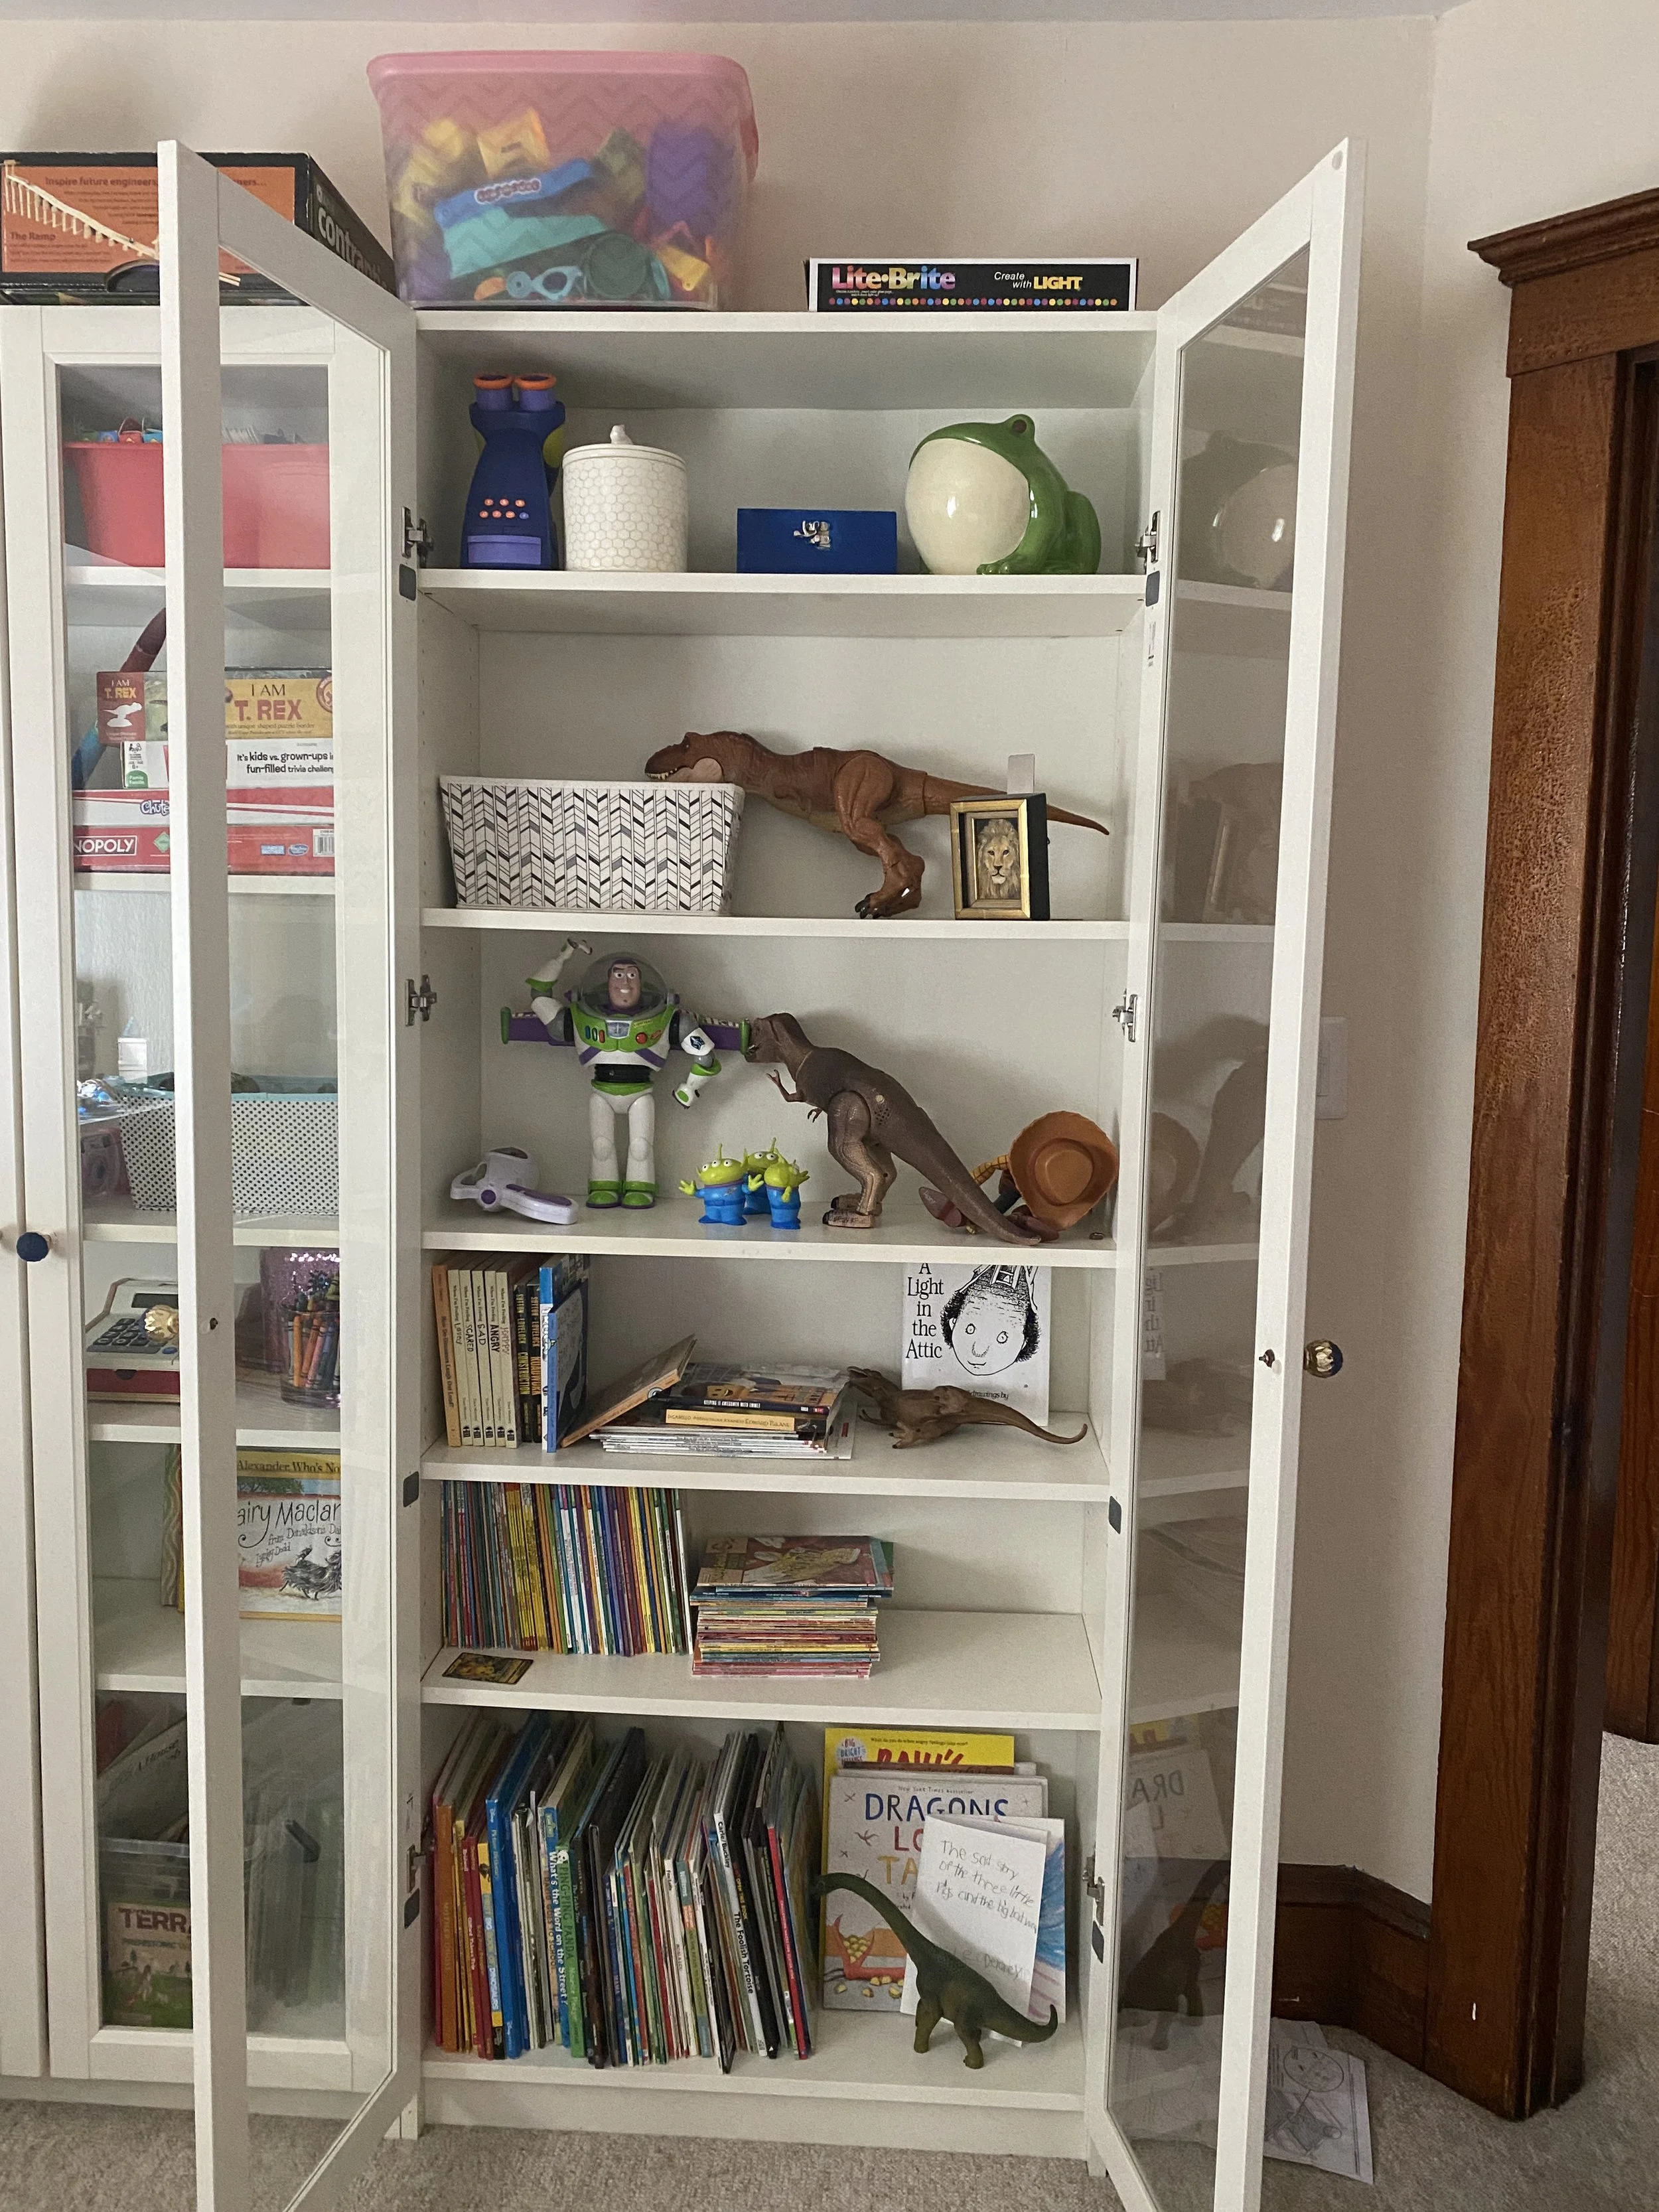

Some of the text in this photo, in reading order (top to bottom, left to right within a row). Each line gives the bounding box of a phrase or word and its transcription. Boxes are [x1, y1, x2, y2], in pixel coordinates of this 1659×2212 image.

[45, 177, 78, 186] Inspire
[80, 176, 108, 185] future
[29, 232, 56, 242] Ramp
[994, 271, 1025, 280] Create
[1033, 276, 1082, 290] LIGHT
[115, 687, 136, 698] REX
[252, 684, 285, 696] I AM
[234, 699, 303, 721] T. REX
[249, 751, 268, 761] kids
[281, 752, 328, 763] grown-ups
[246, 764, 286, 774] fun-filled
[918, 1262, 932, 1274] A
[907, 1277, 944, 1299] Light
[516, 1293, 524, 1313] SUTTON
[916, 1301, 932, 1317] in
[465, 1325, 474, 1352] SCARED
[477, 1323, 486, 1345] SAD
[490, 1324, 500, 1353] ANGRY
[517, 1318, 526, 1344] LOVELOCK
[532, 1321, 540, 1347] LOVELOCK
[912, 1319, 936, 1336] the
[500, 1327, 510, 1355] HAPPY
[906, 1339, 942, 1359] Attic
[518, 1352, 530, 1394] CONSTRUCTION
[1001, 1392, 1009, 1400] by
[293, 1461, 323, 1473] Who's
[326, 1463, 340, 1473] No
[275, 1500, 341, 1528] Maclar
[268, 1523, 326, 1546] from Donaldson's
[275, 1542, 291, 1555] Dodd
[840, 1747, 861, 1757] BRIGHT
[844, 1738, 855, 1748] BIG
[865, 1793, 1009, 1822] DRAGONS
[549, 1851, 559, 1885] What's
[940, 1840, 966, 1860] The
[997, 1861, 1019, 1881] story
[560, 1867, 573, 1920] PING-PING
[680, 1871, 688, 1897] Willems
[973, 1872, 1009, 1894] three
[1009, 1885, 1034, 1907] little
[551, 1889, 560, 1905] the
[718, 1821, 754, 1994] Carle/Buckley The Foolish Tortoise
[958, 1891, 977, 1904] and
[979, 1895, 994, 1909] the
[118, 1906, 190, 1934] TERR
[553, 1907, 563, 1932] Word
[556, 1935, 563, 1945] on
[563, 1925, 575, 1959] PANDA
[488, 1967, 499, 2010] DINOSAURS
